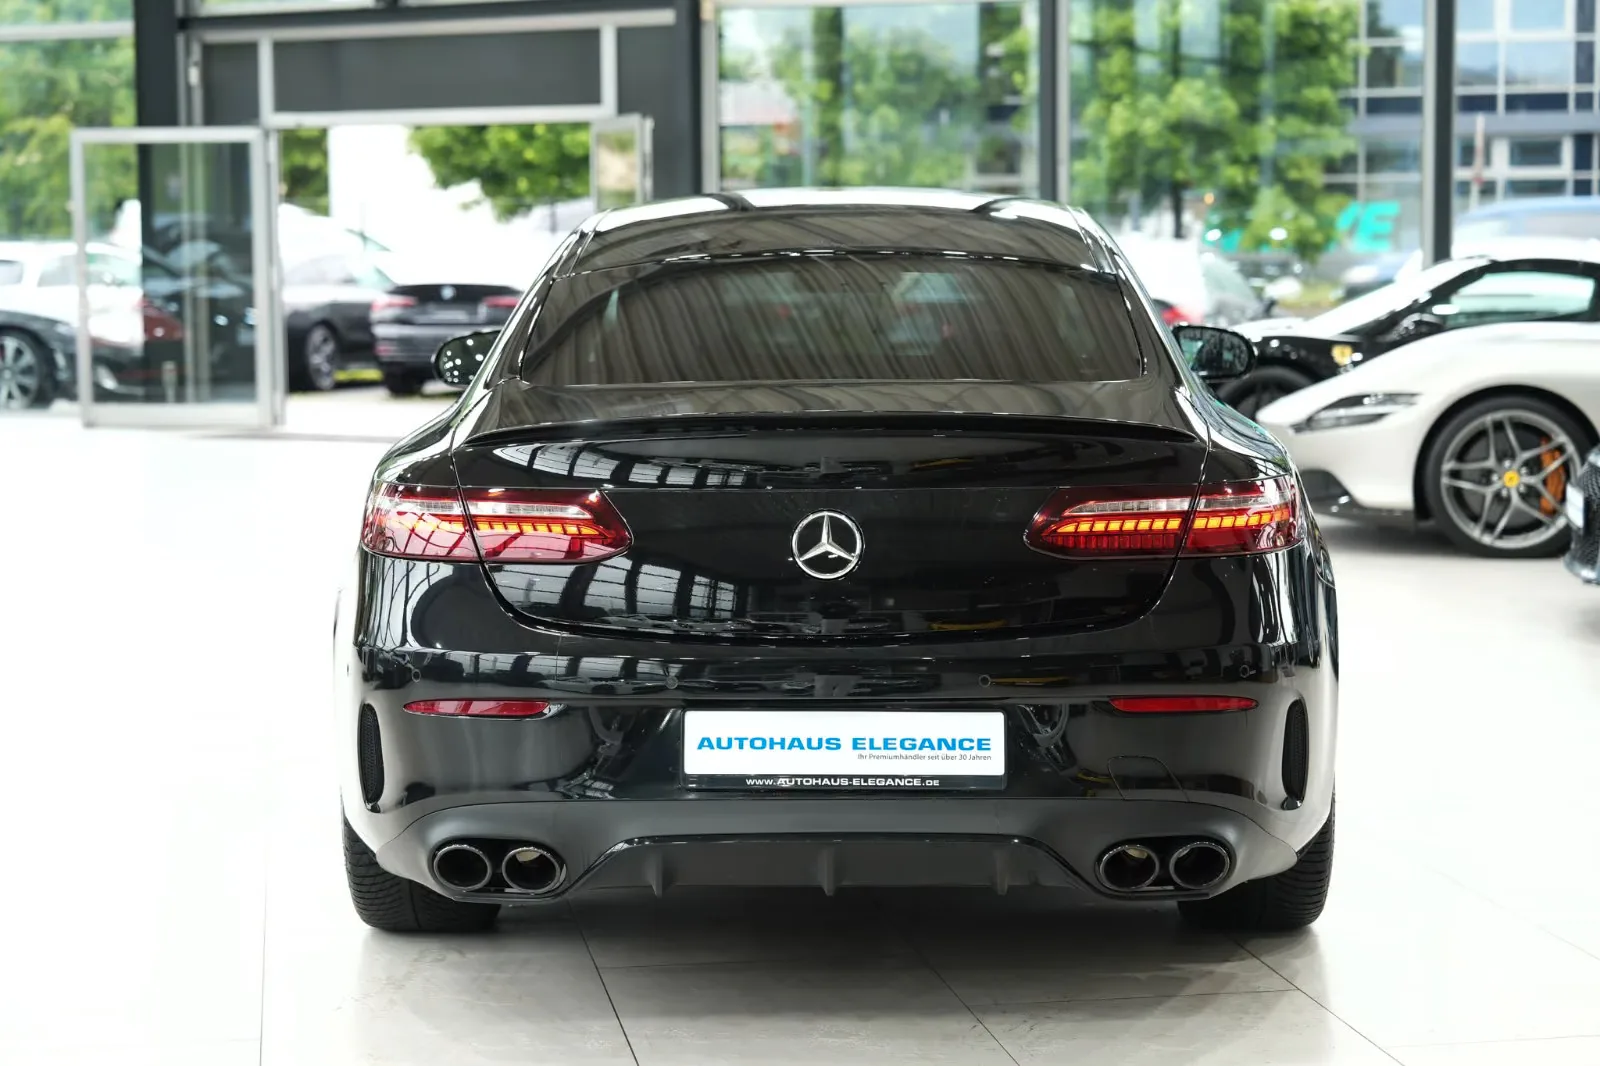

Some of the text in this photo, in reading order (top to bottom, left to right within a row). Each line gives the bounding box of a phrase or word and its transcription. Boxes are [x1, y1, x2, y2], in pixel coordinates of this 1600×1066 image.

[697, 737, 992, 751] AUTOHAUS ELEGANCE
[869, 753, 926, 761] Premiumhändler
